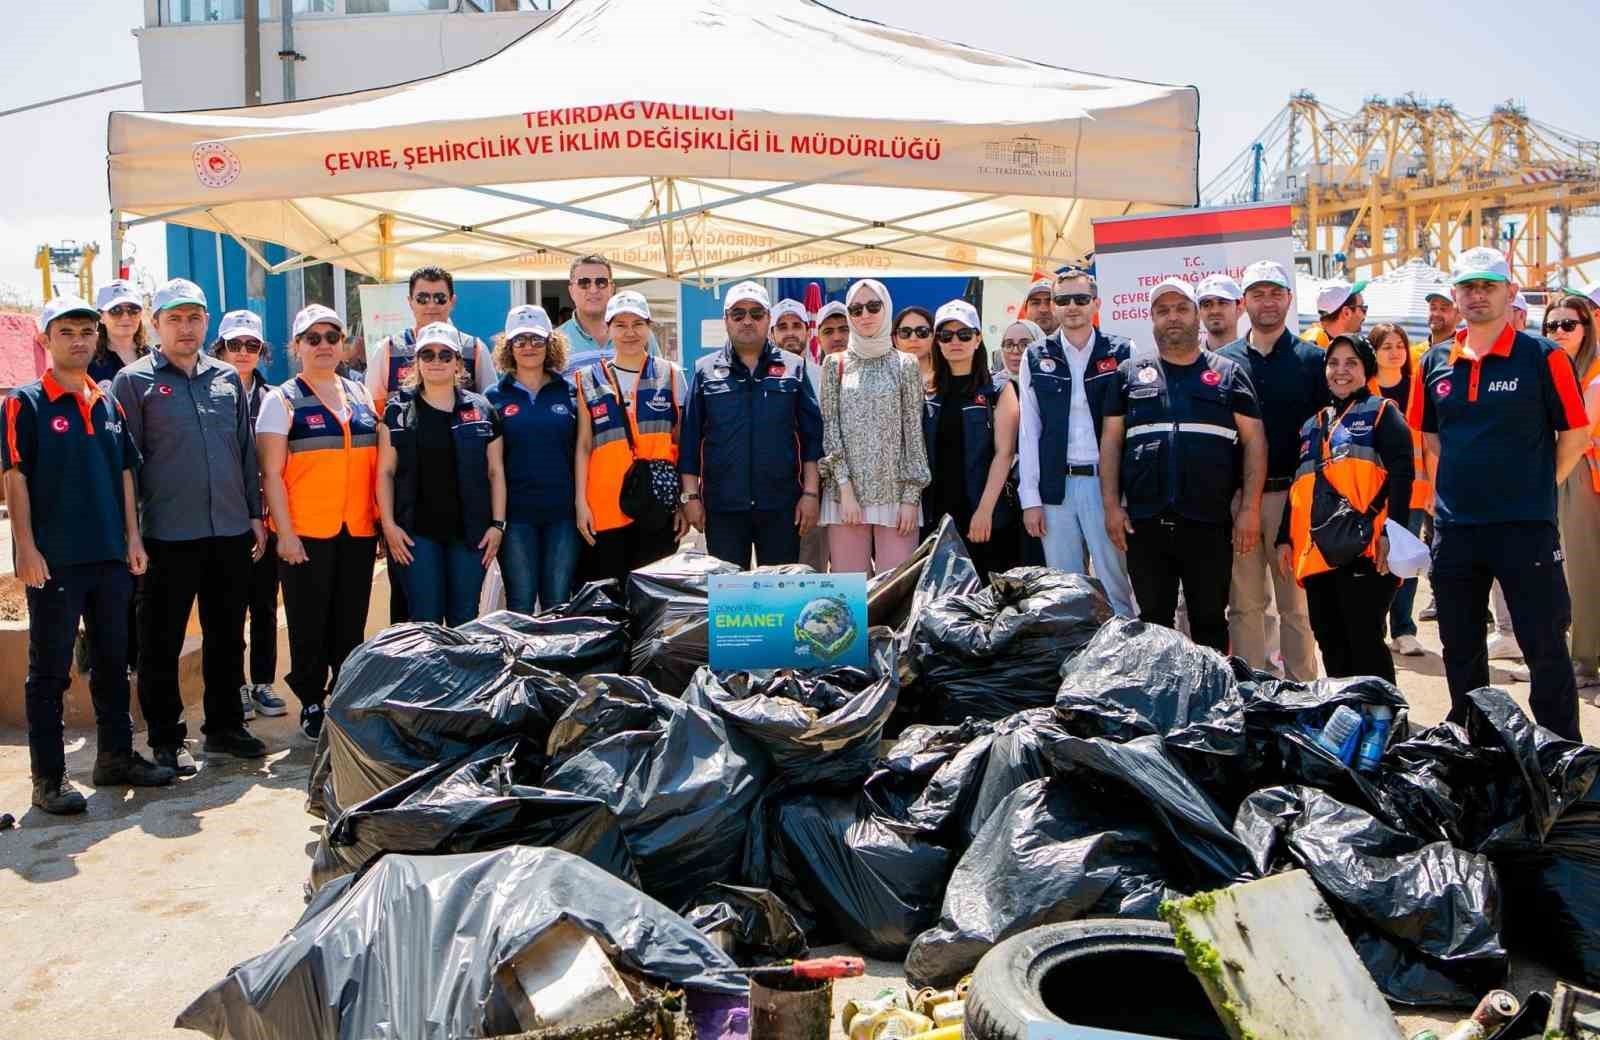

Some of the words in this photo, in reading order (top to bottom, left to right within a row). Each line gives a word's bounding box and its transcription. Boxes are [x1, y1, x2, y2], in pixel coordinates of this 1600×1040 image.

[325, 149, 398, 176] ÇEVRE,
[403, 135, 520, 170] ŞEHİRCİLİK
[525, 135, 553, 154] VE
[559, 128, 620, 152] İKLİM
[626, 127, 759, 154] DEĞİŞİKLİĞİ
[766, 129, 784, 153] İL
[791, 132, 941, 161] MÜDÜRLÜĞÜ
[1183, 256, 1205, 267] T.C.
[1488, 378, 1519, 392] AFAD
[716, 613, 784, 628] EMANET
